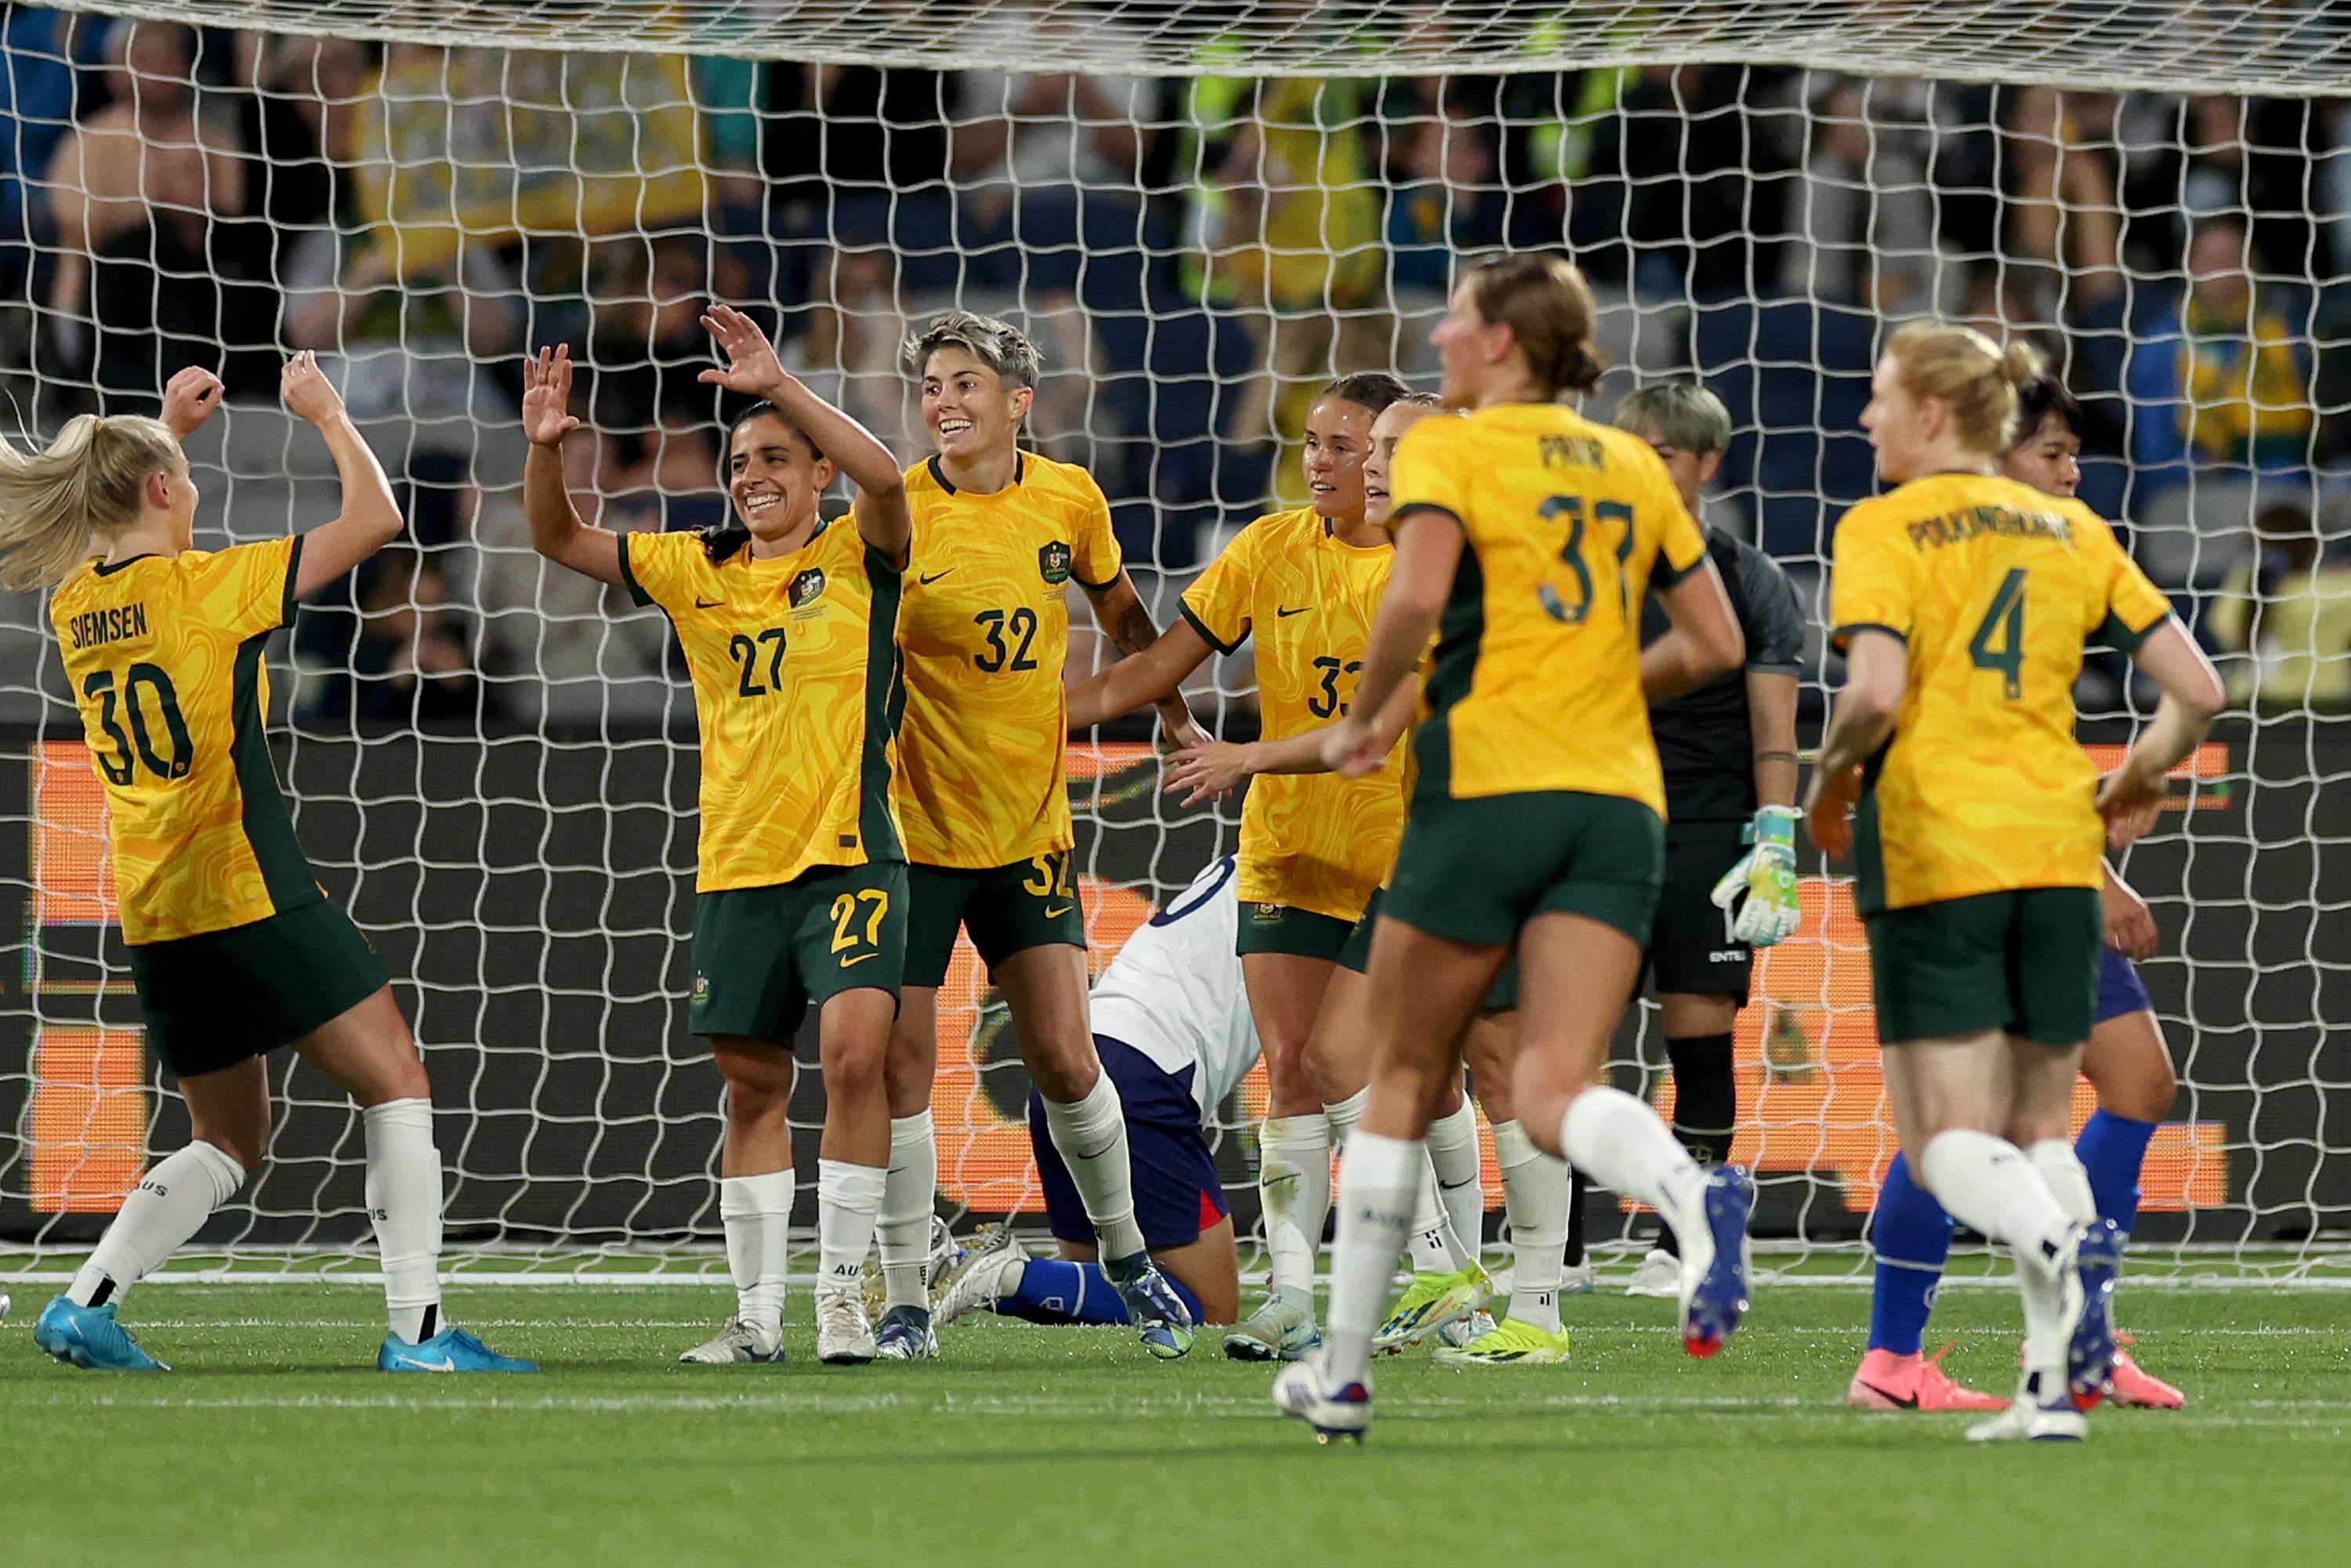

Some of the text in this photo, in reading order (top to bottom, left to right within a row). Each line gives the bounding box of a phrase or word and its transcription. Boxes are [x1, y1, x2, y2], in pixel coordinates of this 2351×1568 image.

[1538, 495, 1633, 625] 37
[71, 602, 147, 649] SIEMSEN
[973, 607, 1038, 673] 32
[1969, 568, 2027, 698] 4
[729, 627, 787, 698] 27
[84, 663, 194, 786] 30
[830, 889, 887, 954] 27
[135, 1181, 168, 1197] US
[835, 1264, 863, 1276] AU
